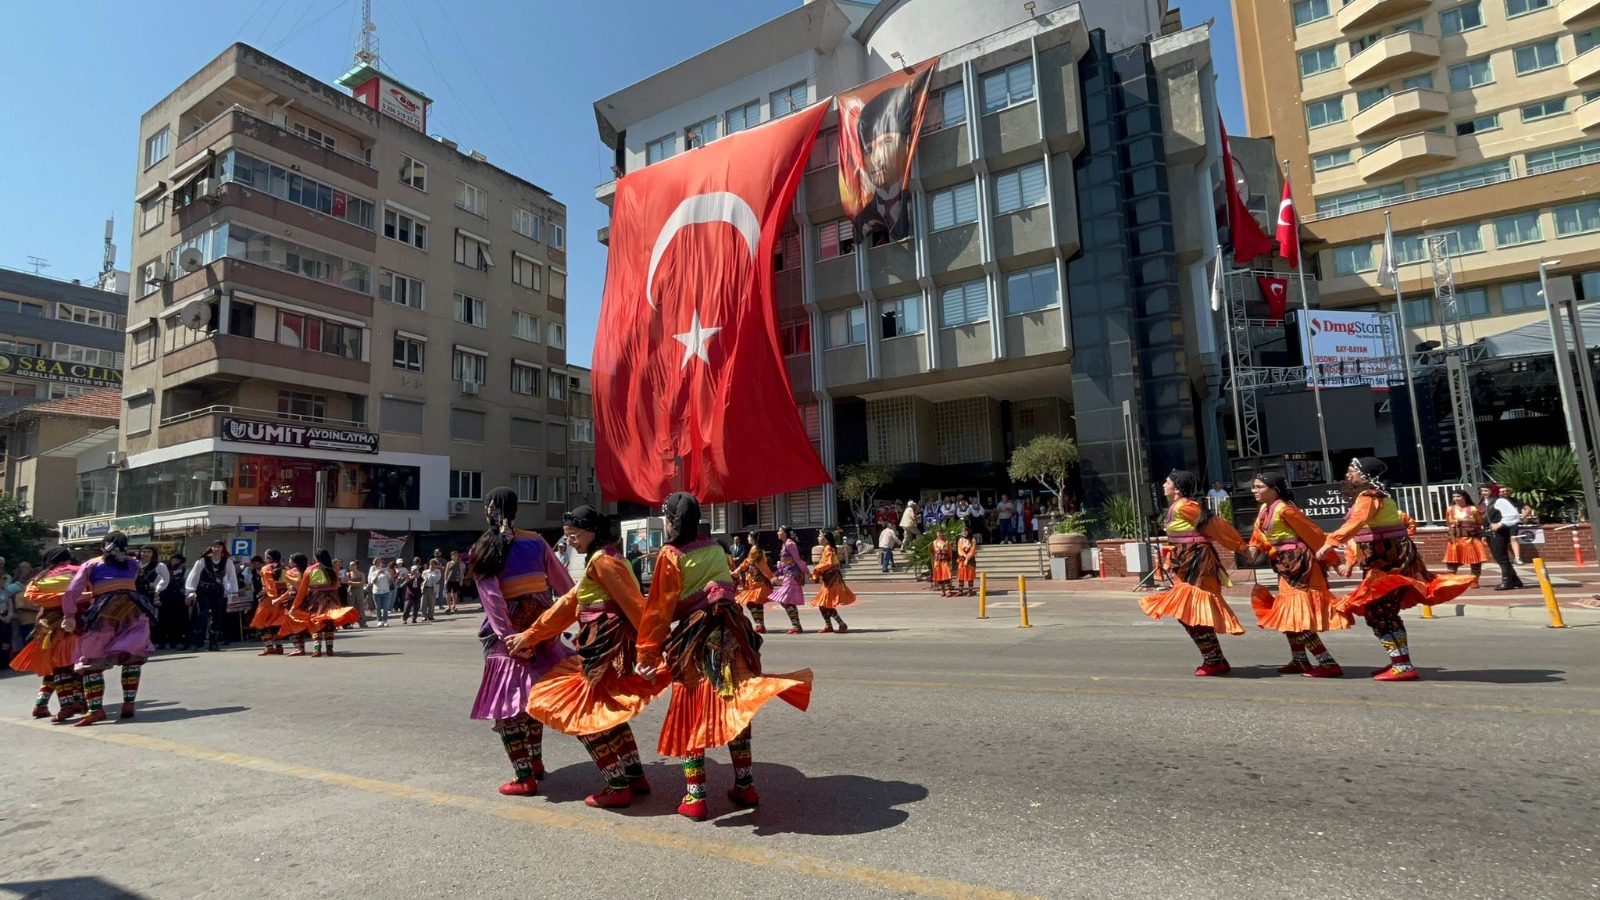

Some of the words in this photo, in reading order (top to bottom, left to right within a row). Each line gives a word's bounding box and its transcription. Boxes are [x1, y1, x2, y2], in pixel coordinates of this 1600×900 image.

[1323, 320, 1390, 335] DmgStone
[18, 356, 65, 375] S&A
[1314, 355, 1337, 363] ERSONEL
[16, 369, 57, 381] GÜZELLİK
[59, 375, 91, 385] ESTETİK
[306, 428, 375, 443] AYDINLATMA
[1308, 495, 1352, 506] NAZİL
[1300, 504, 1351, 516] ELEDİ
[235, 540, 249, 555] P
